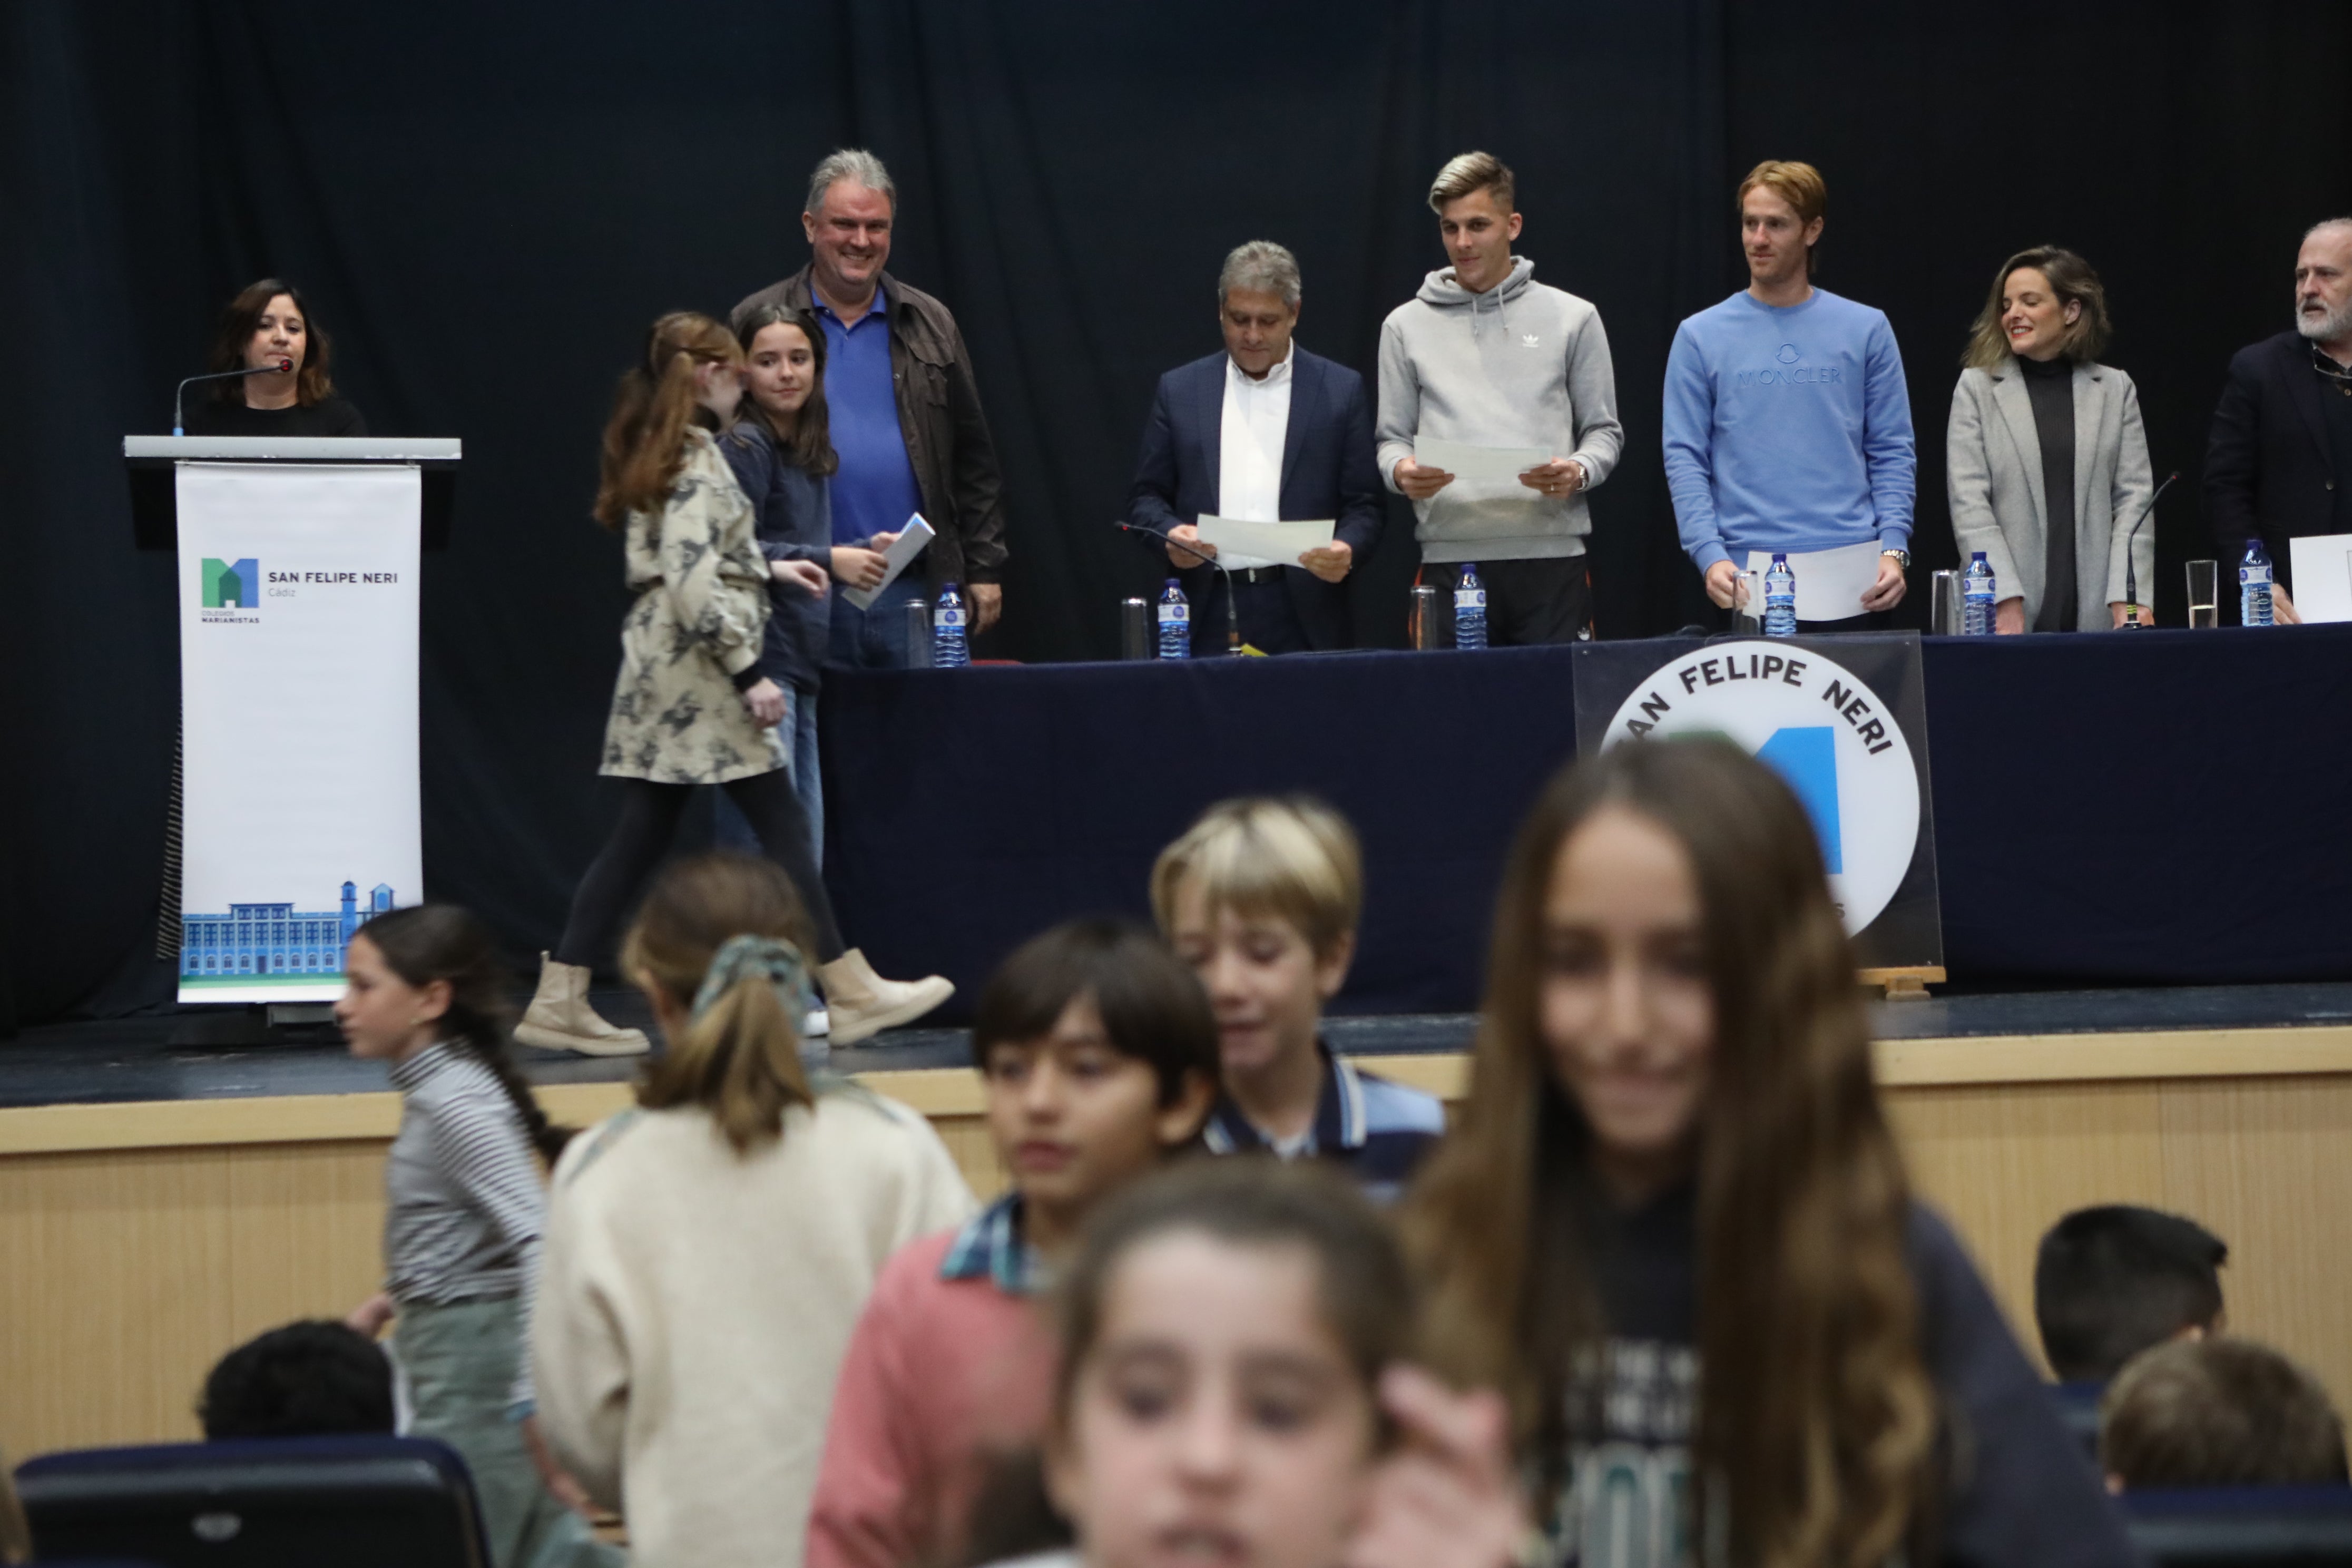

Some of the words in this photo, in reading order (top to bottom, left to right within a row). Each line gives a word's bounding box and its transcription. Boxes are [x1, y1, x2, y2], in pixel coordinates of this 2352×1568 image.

[1738, 368, 1842, 386] MONCLER
[269, 572, 299, 582] SAN
[306, 573, 357, 583] FELIPE
[363, 573, 397, 583] NERI
[269, 587, 296, 597] Cádiz
[1620, 691, 1671, 744] AN
[1679, 654, 1807, 694] FELIPE
[1821, 680, 1893, 756] NERI
